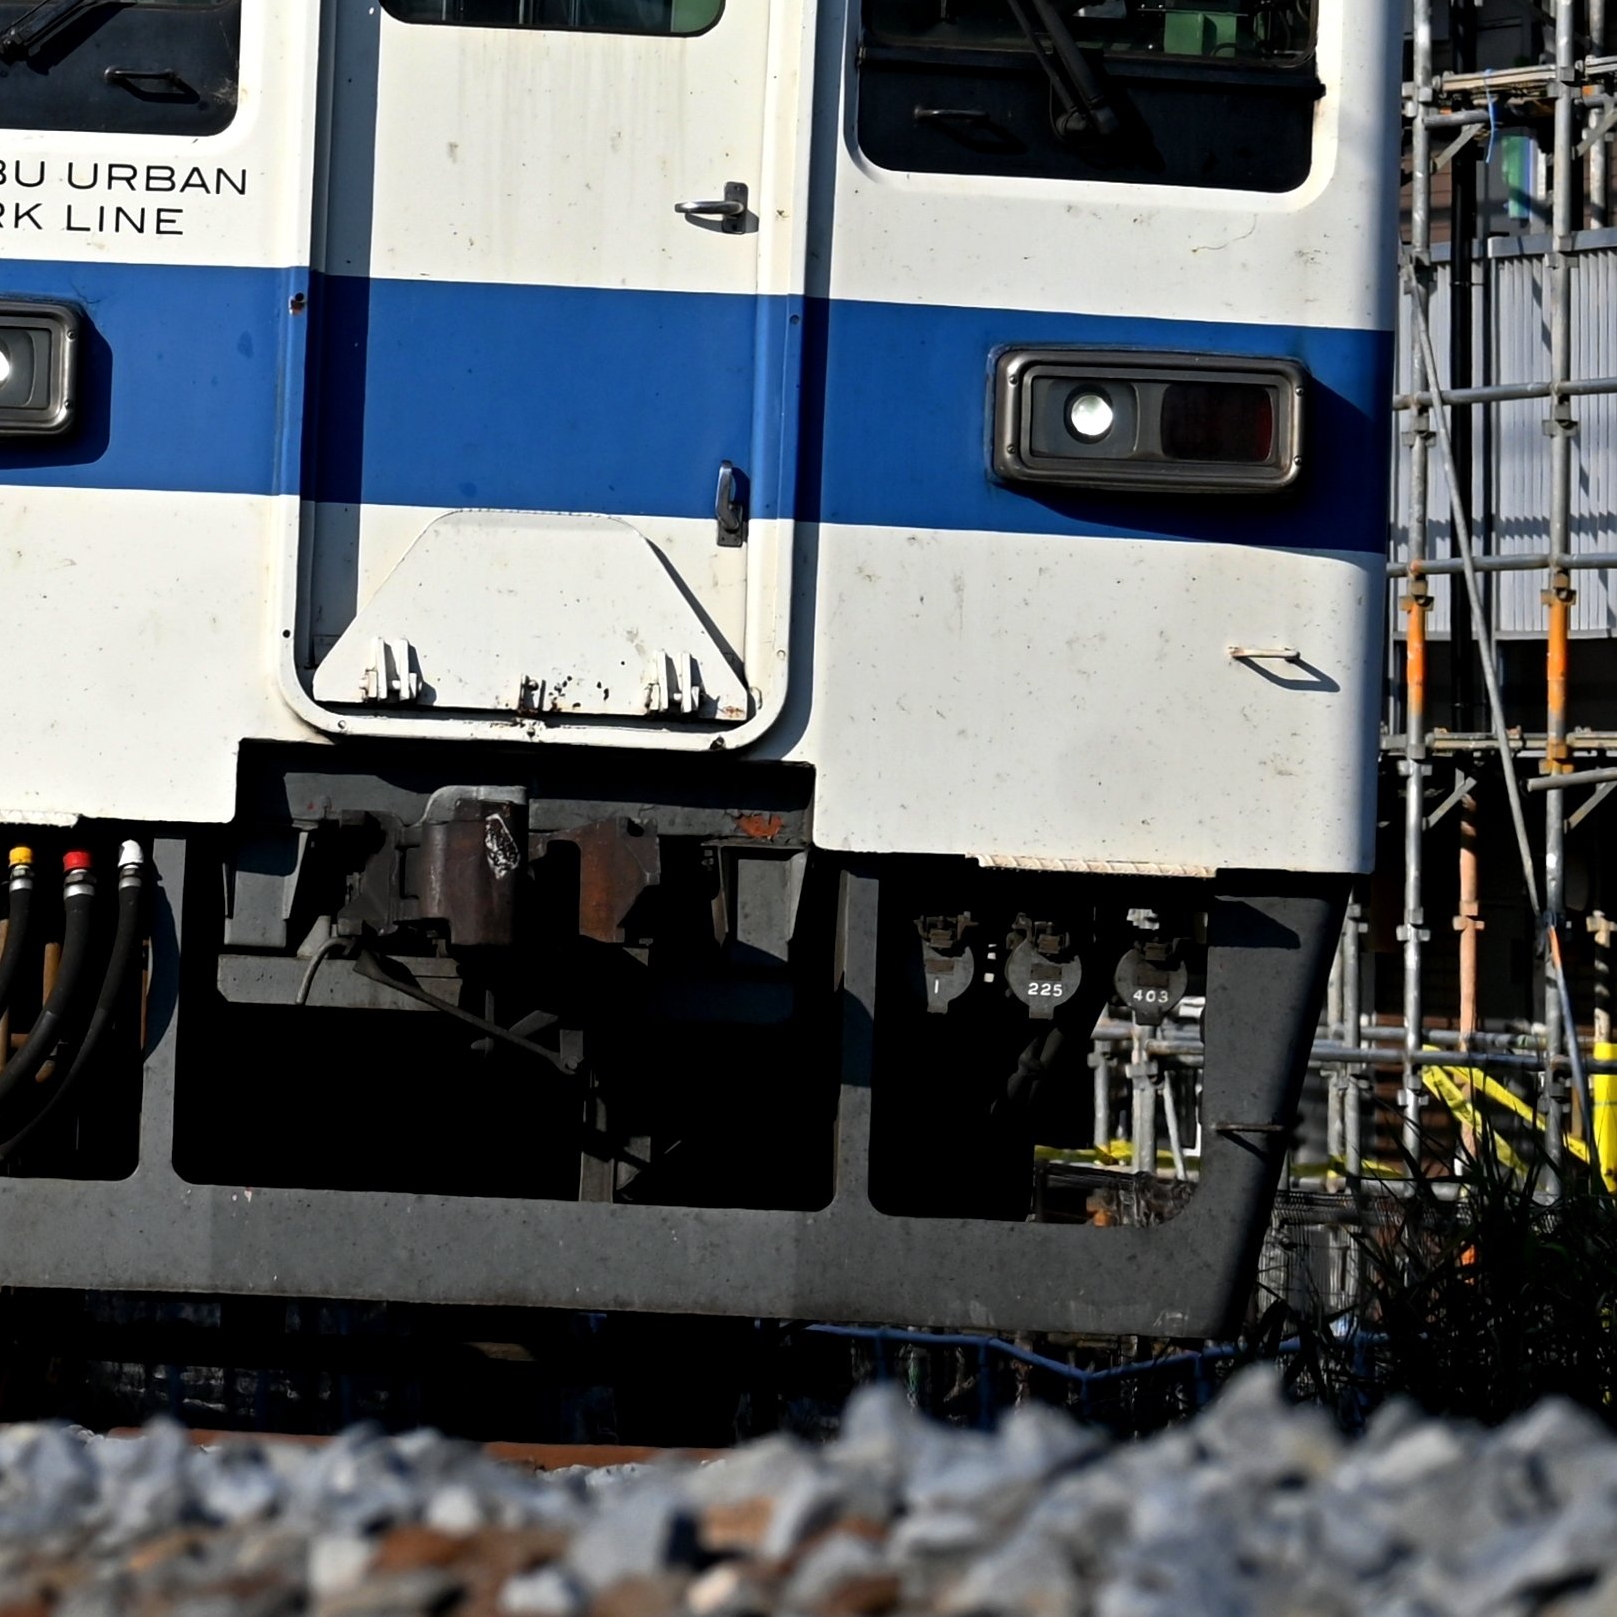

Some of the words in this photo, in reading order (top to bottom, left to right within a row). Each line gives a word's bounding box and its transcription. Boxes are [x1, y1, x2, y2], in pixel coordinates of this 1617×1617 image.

[67, 162, 247, 195] URBAN
[66, 204, 184, 235] LINE
[1027, 982, 1063, 997] 225
[1133, 989, 1169, 1003] 403
